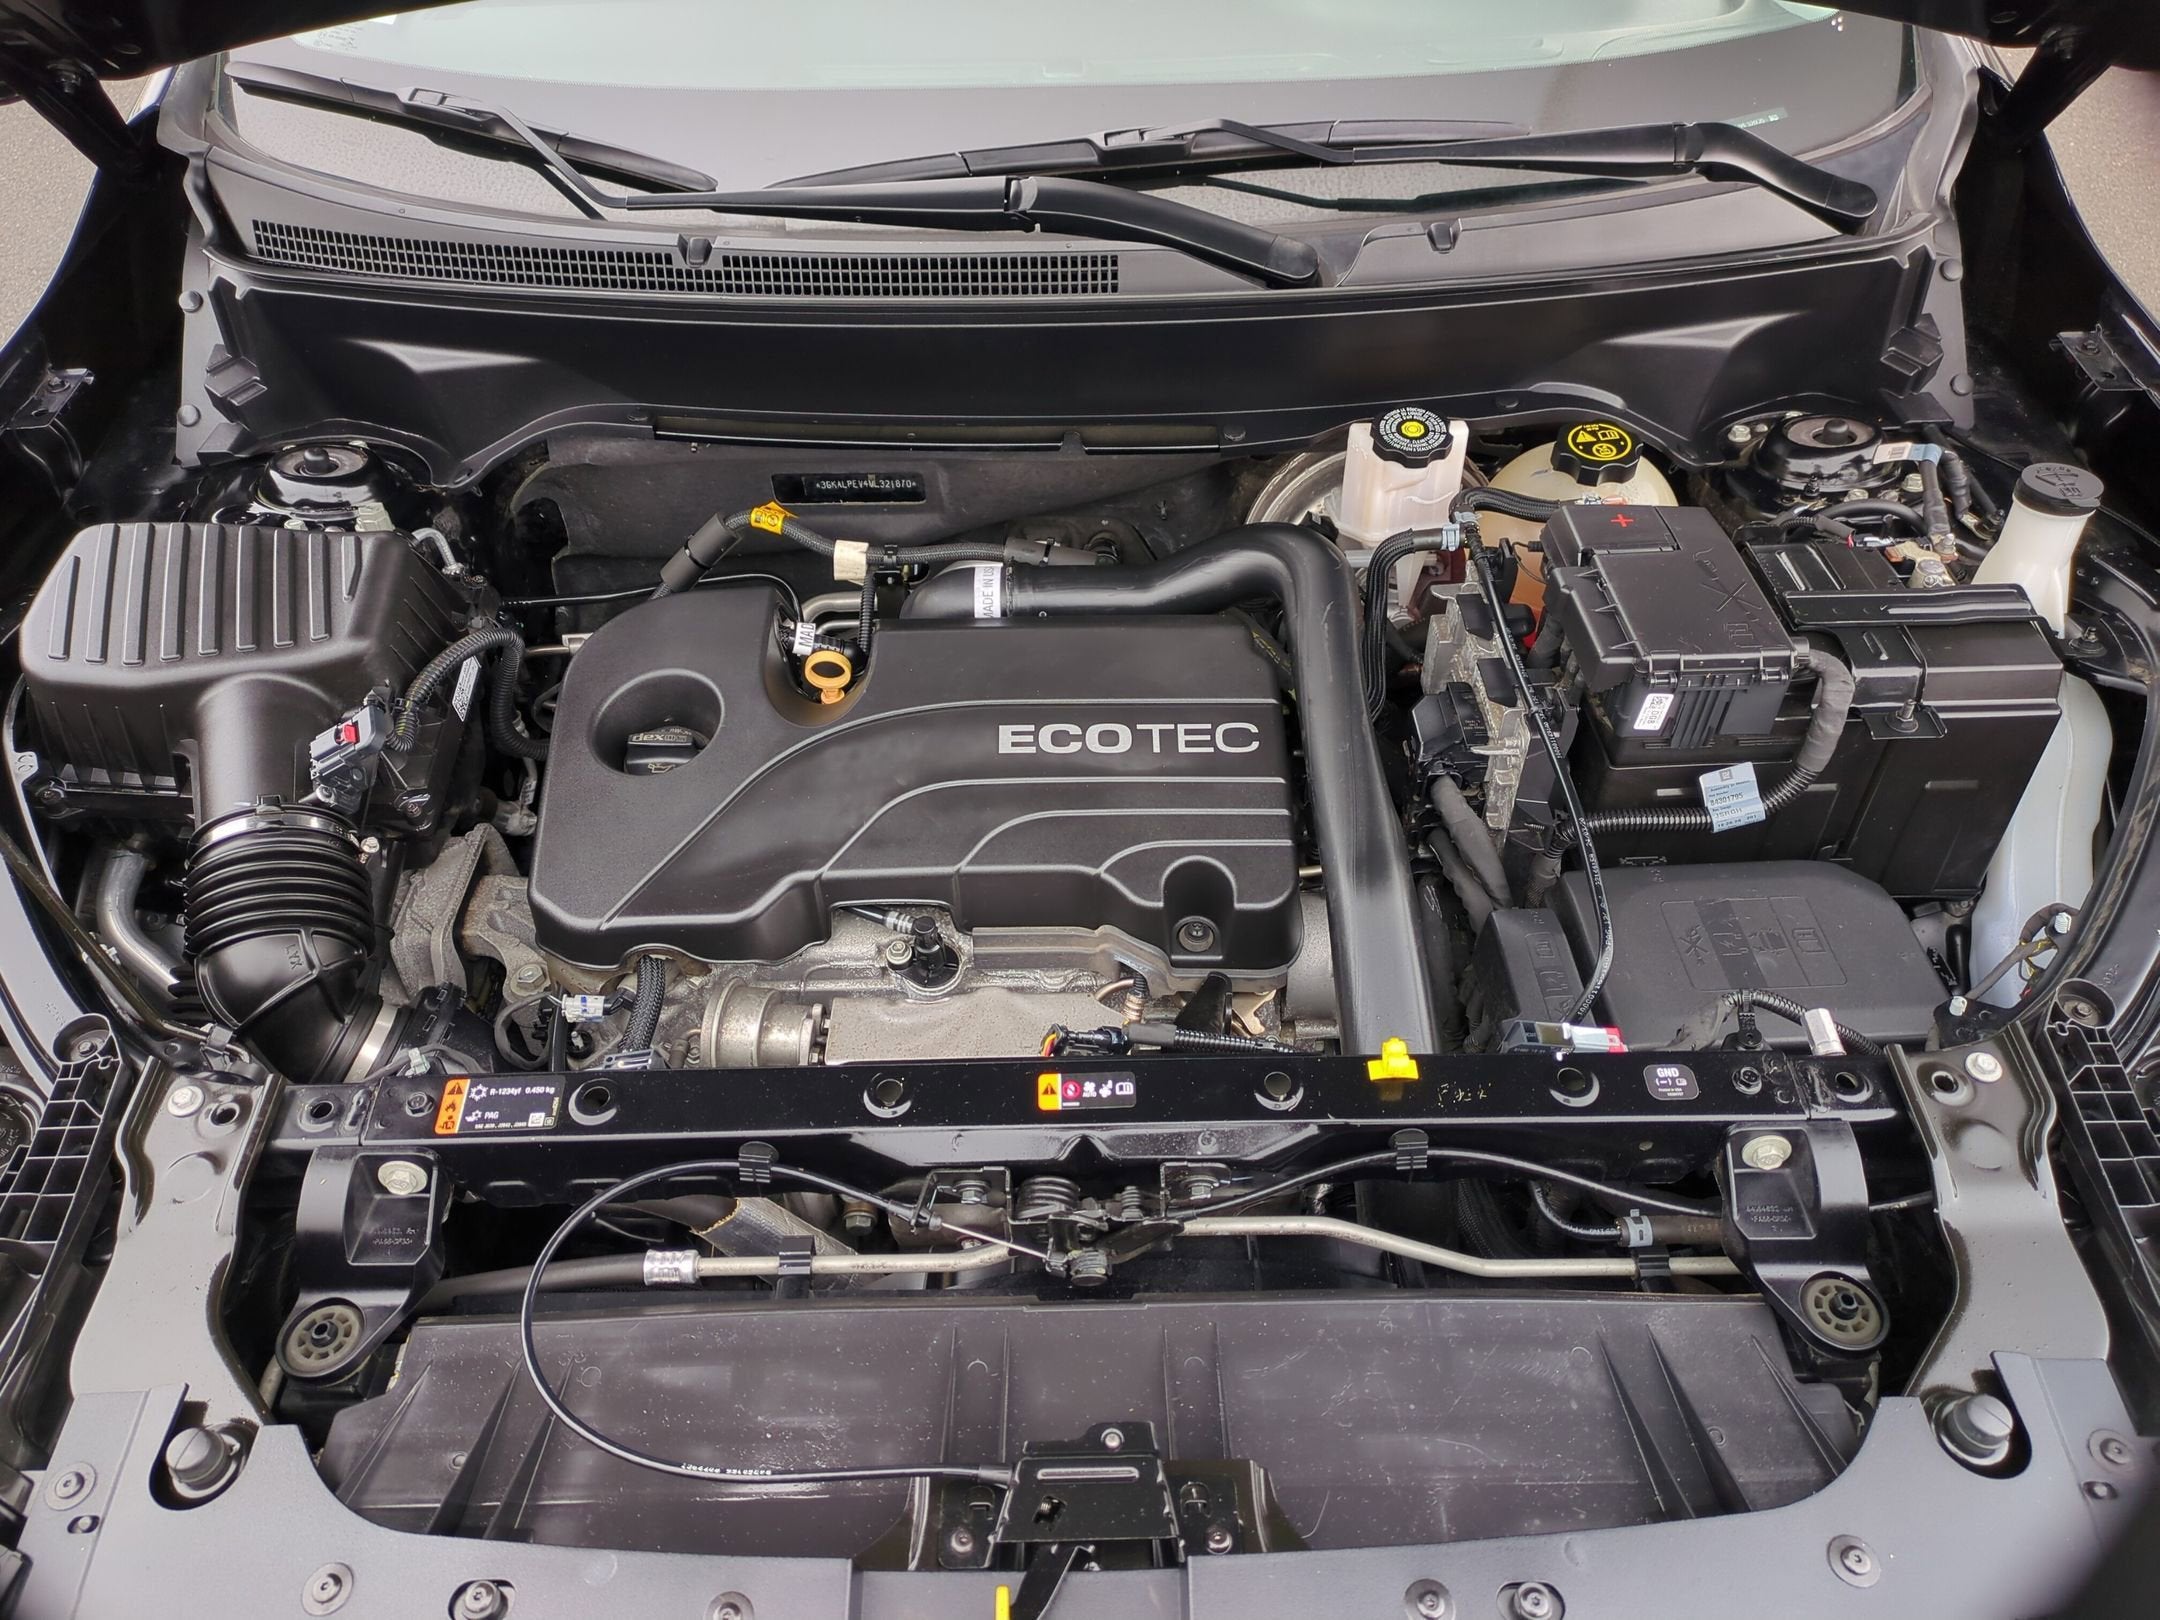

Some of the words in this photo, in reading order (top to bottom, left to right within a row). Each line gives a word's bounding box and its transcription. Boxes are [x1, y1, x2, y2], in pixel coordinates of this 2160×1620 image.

[982, 579, 994, 588] IN
[998, 722, 1260, 754] ECOTEC
[1657, 1068, 1679, 1077] GND
[490, 1087, 521, 1096] R-1234yf
[525, 1086, 544, 1094] 0.450
[546, 1086, 555, 1095] kg
[484, 1111, 499, 1119] PAG
